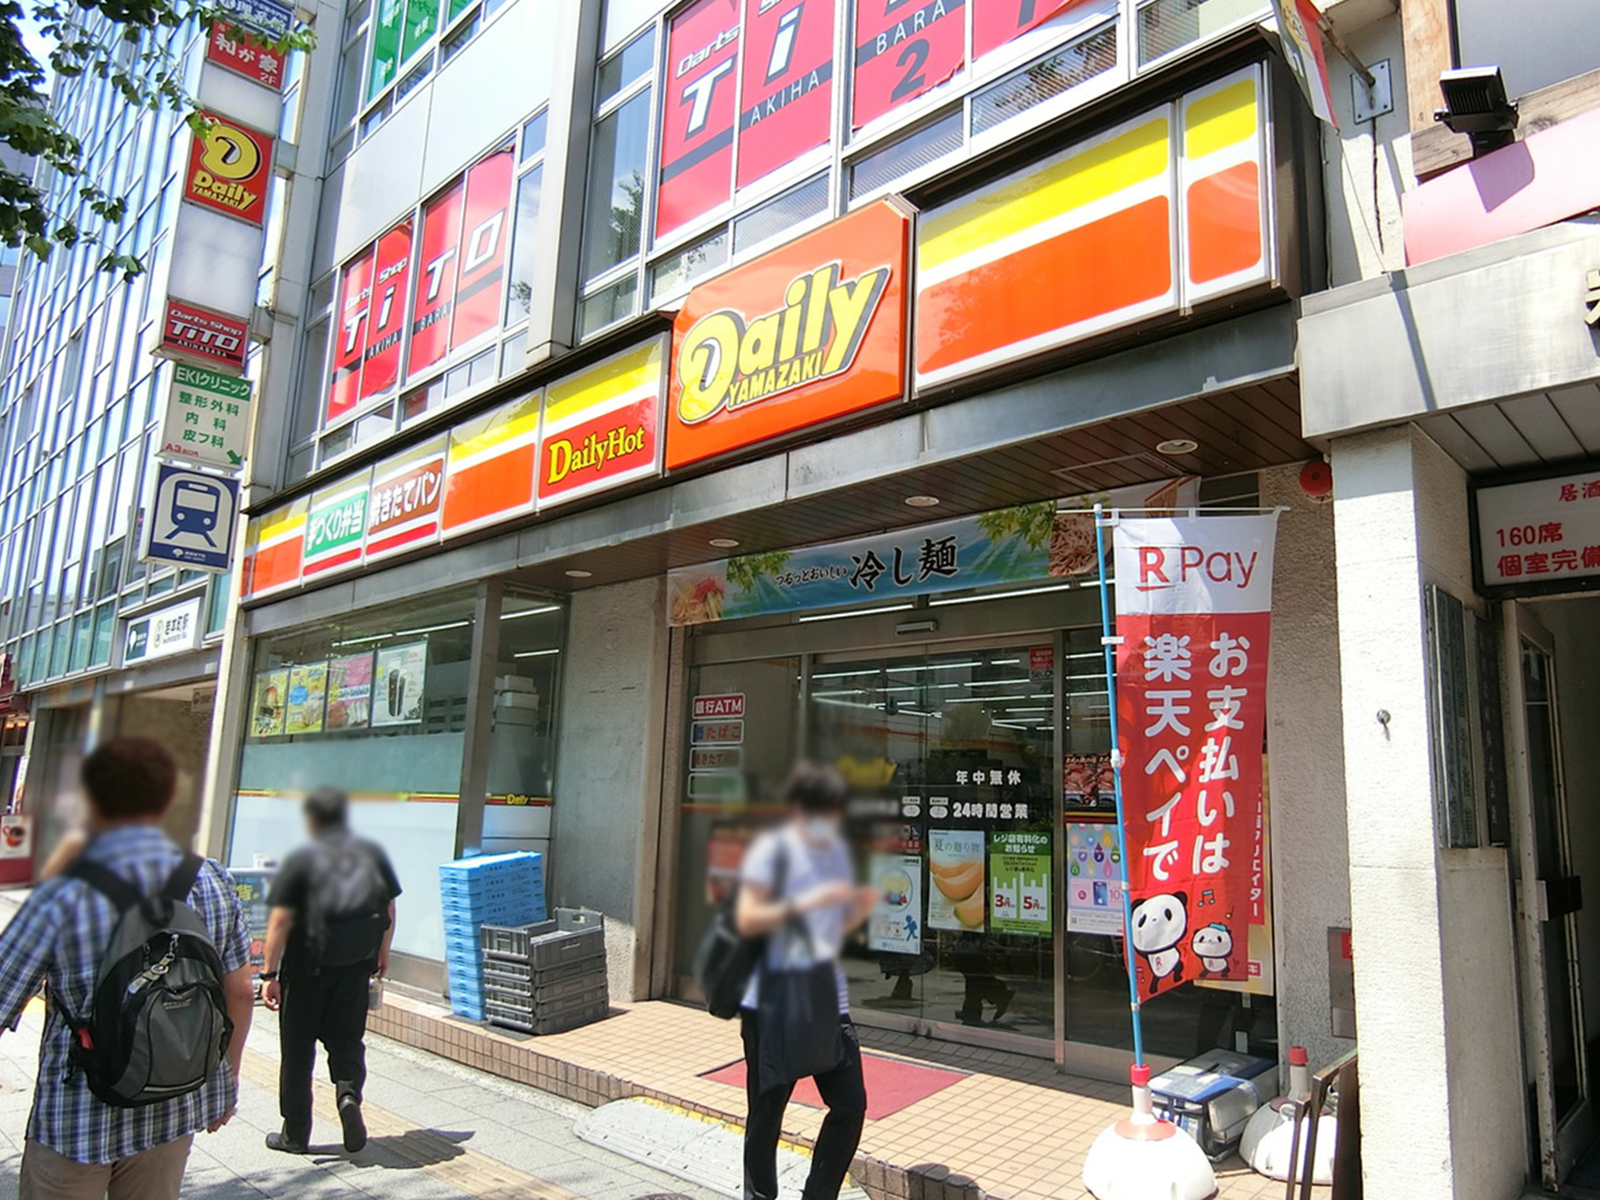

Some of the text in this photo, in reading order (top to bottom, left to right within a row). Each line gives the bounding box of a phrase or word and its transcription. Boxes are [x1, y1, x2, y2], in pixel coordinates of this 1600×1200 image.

[214, 32, 279, 75] 和が家
[676, 24, 740, 79] Darts
[260, 71, 277, 85] 2F
[192, 184, 240, 208] YAMAZAKI
[193, 169, 259, 212] Daily
[378, 256, 408, 285] Shop
[170, 309, 242, 336] Darts Shop
[170, 319, 240, 351] TiTO
[177, 339, 228, 358] AKIHABARA
[678, 259, 892, 425] Daily
[175, 366, 250, 397] EKIクリニック
[729, 350, 824, 408] YAMAZAKI
[179, 391, 240, 417] 整形外科
[182, 429, 225, 449] 皮フ科
[547, 426, 645, 485] DailyHot
[370, 471, 442, 529] 焼きたてパン
[1496, 521, 1563, 548] 160席
[773, 534, 960, 592] つるっとおいしい 冷し麺
[1180, 545, 1259, 589] Pay
[695, 698, 743, 715] 銀行ATM
[705, 725, 741, 739] たばこ
[1142, 633, 1192, 880] 楽天ペイで
[1192, 632, 1250, 875] お支払いは
[955, 769, 1022, 786] 年中無休
[952, 802, 1029, 820] 24時間営業
[993, 833, 1048, 845] レジ袋有料化の
[1004, 844, 1036, 854] お知らせ
